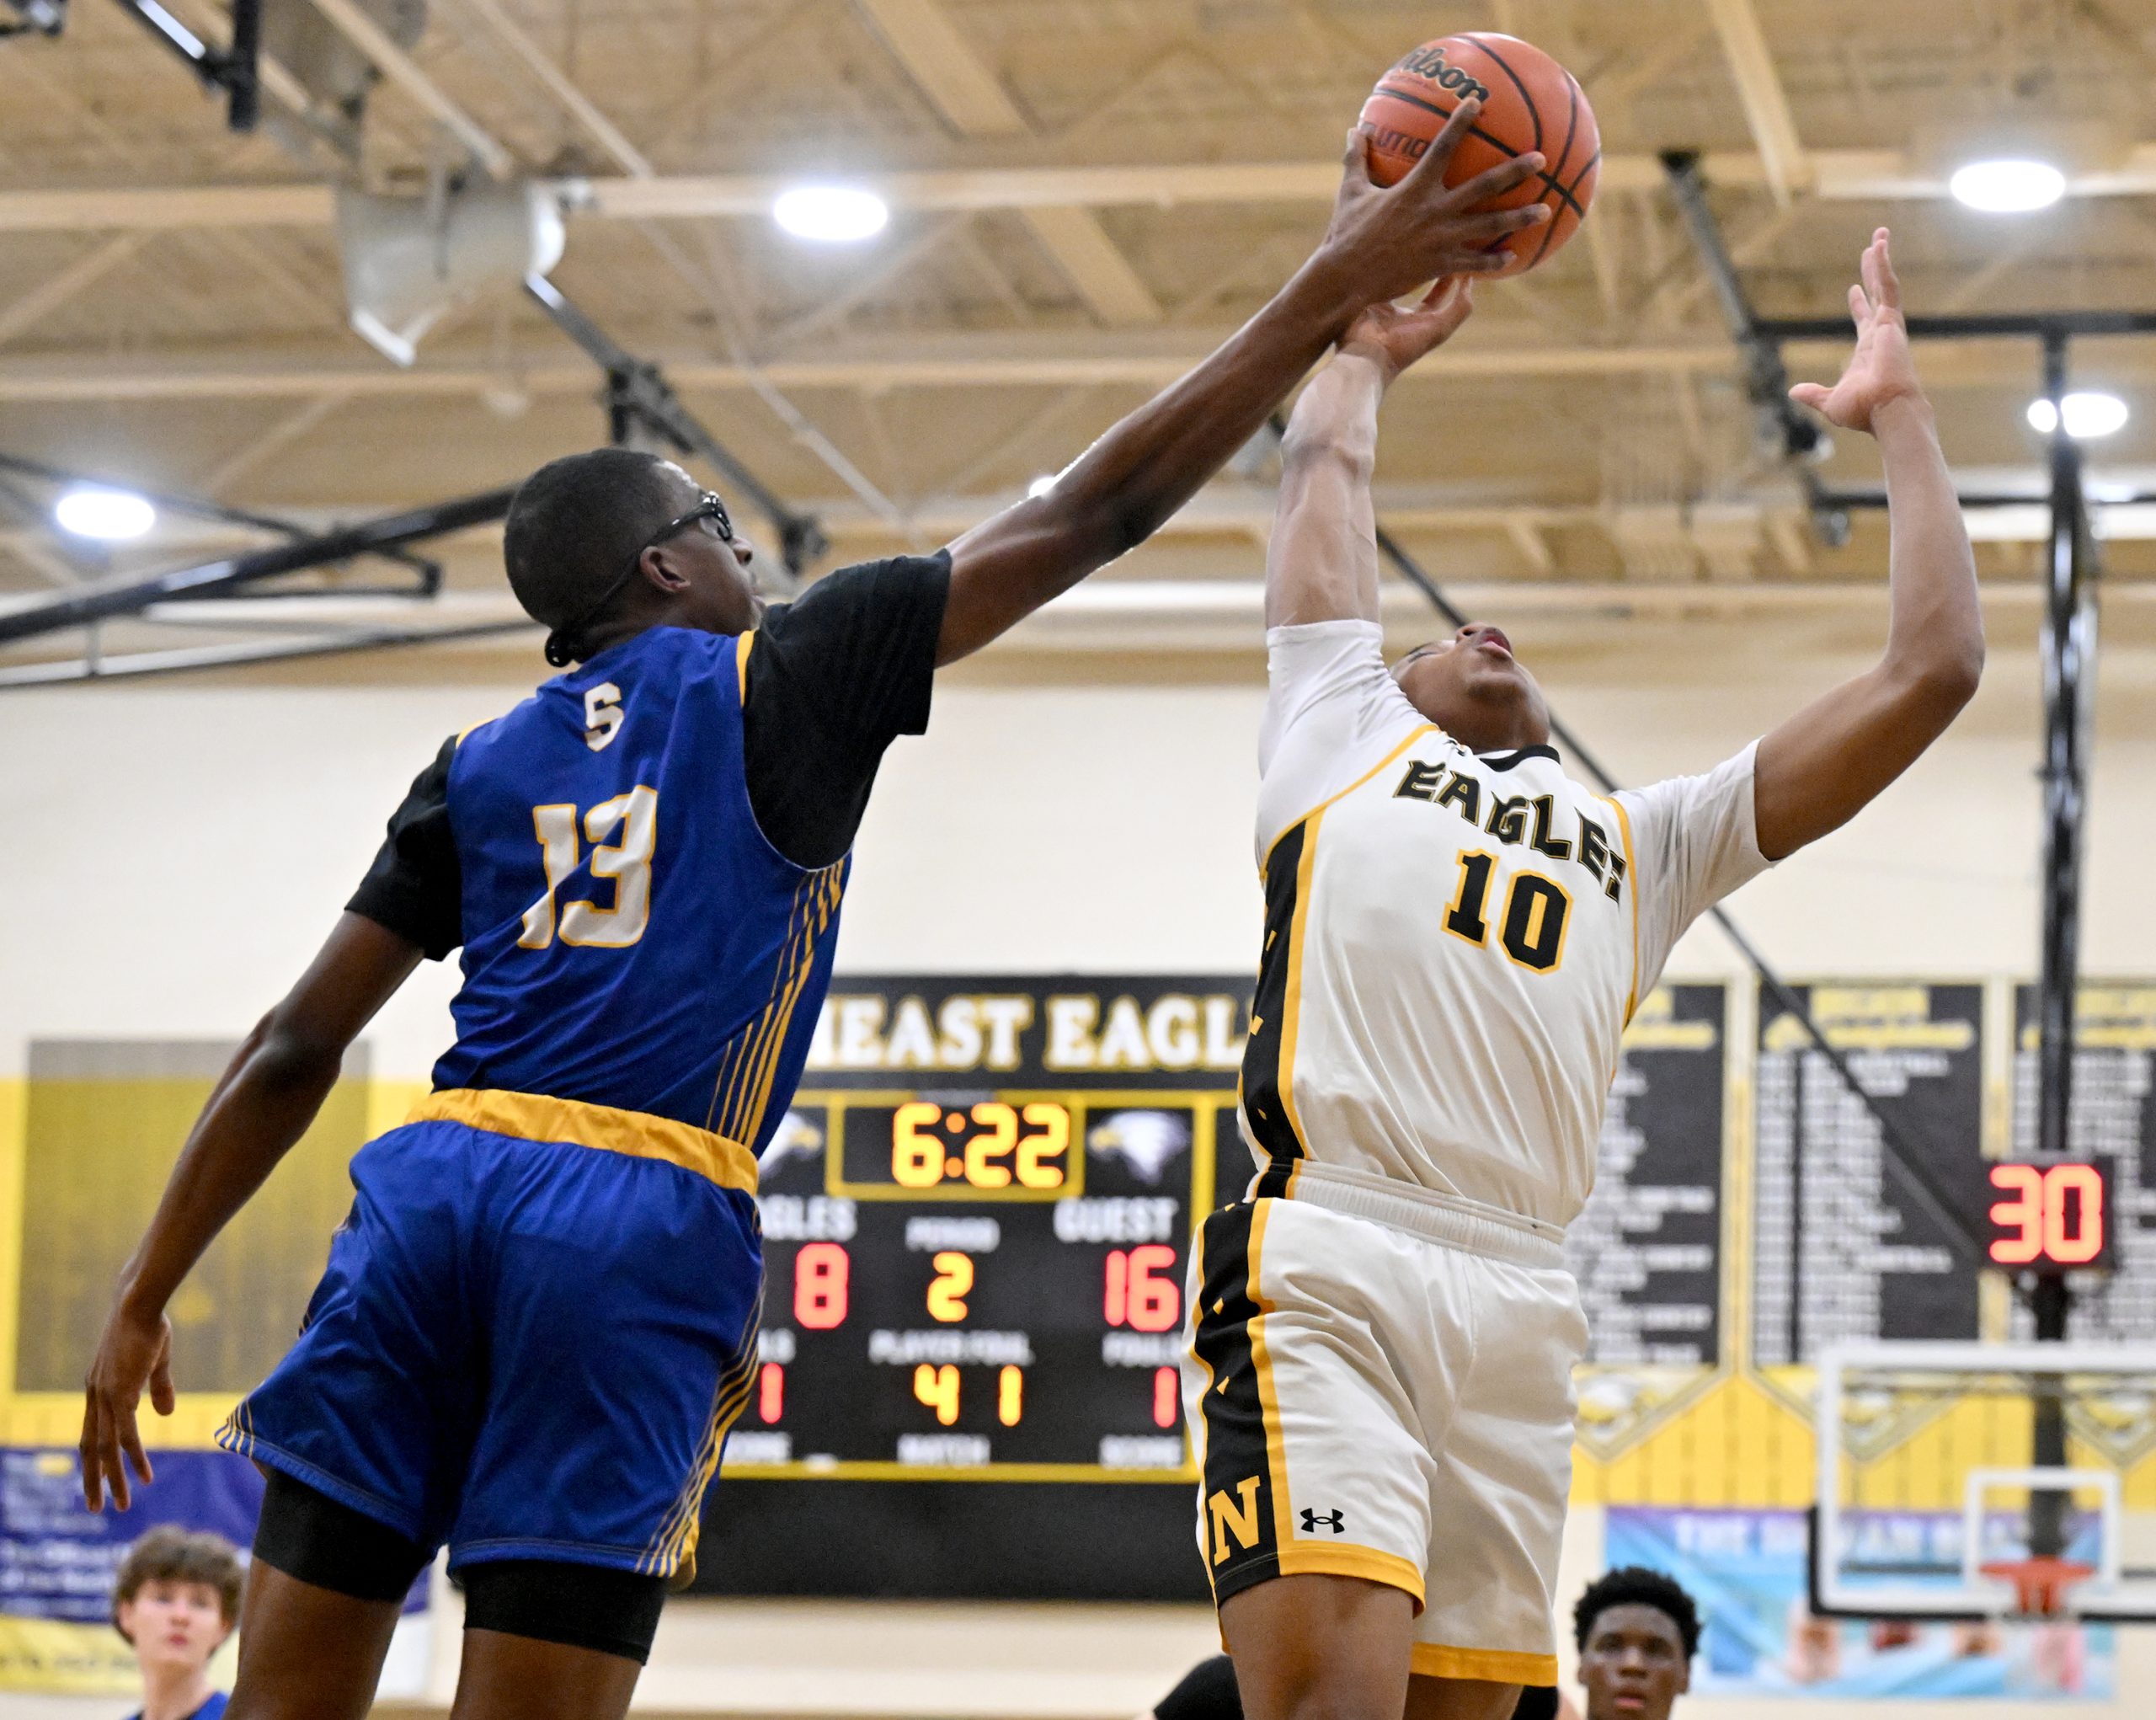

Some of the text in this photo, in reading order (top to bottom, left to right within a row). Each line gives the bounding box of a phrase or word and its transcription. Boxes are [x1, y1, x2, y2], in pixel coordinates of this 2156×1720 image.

[1395, 46, 1490, 103] ilson
[517, 784, 658, 949] 13
[1441, 847, 1574, 975] 10
[1044, 994, 1250, 1071] EAGL
[893, 1102, 1070, 1189] 6:22
[760, 1196, 857, 1242] GLES
[1054, 1198, 1177, 1242] GUEST
[1989, 1164, 2104, 1263] 30
[794, 1242, 849, 1329] 8
[927, 1252, 974, 1322] 2
[1104, 1245, 1179, 1332] 16
[760, 1363, 784, 1424] 1
[1154, 1366, 1177, 1428] 1
[1209, 1475, 1261, 1567] N
